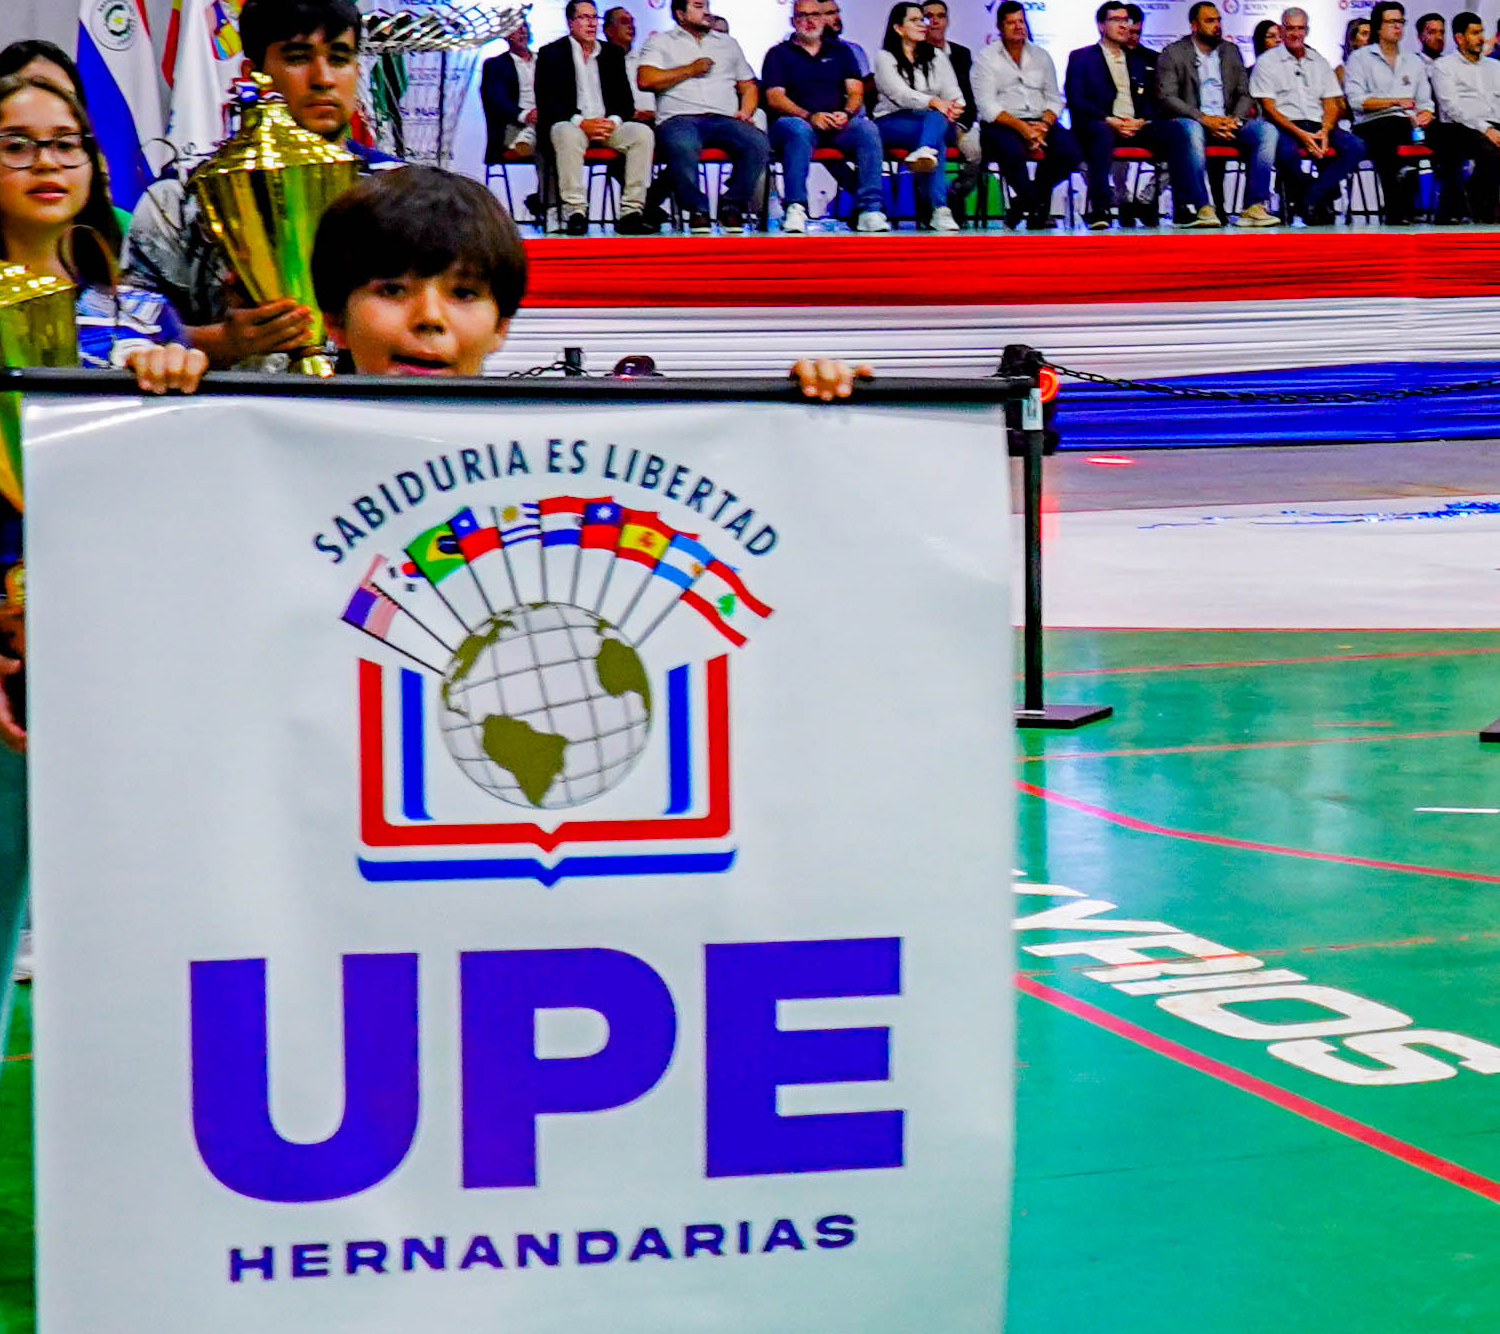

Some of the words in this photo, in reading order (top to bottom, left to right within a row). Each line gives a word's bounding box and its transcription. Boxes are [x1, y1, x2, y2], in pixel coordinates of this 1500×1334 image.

[312, 439, 533, 565] SABIDURIA
[546, 437, 590, 475] ES
[603, 442, 781, 557] LIBERTAD
[190, 936, 905, 1204] UPE
[229, 1213, 859, 1284] HERNANDARIAS
